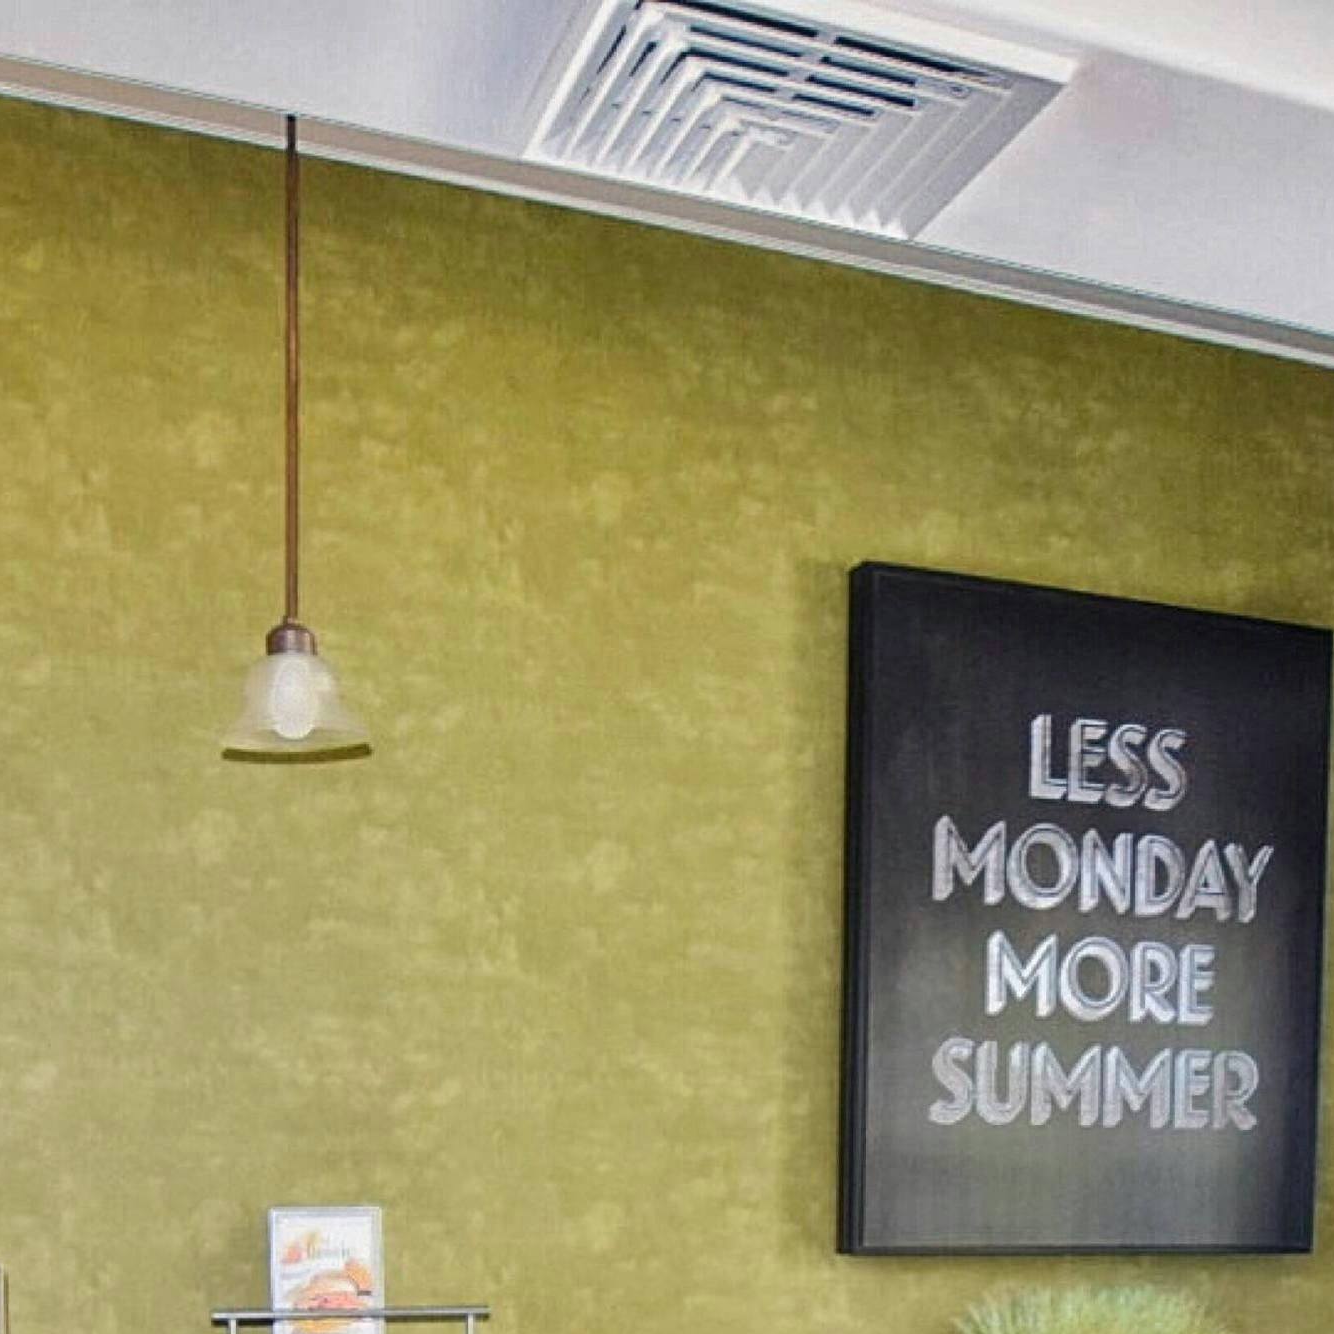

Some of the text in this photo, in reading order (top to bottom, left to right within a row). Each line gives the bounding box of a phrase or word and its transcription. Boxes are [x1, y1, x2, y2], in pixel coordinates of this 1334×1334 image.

[1029, 714, 1189, 811] LESS
[931, 815, 1273, 922] MONDAY
[986, 931, 1216, 1026] MORE
[928, 1036, 1260, 1131] SUMMER
